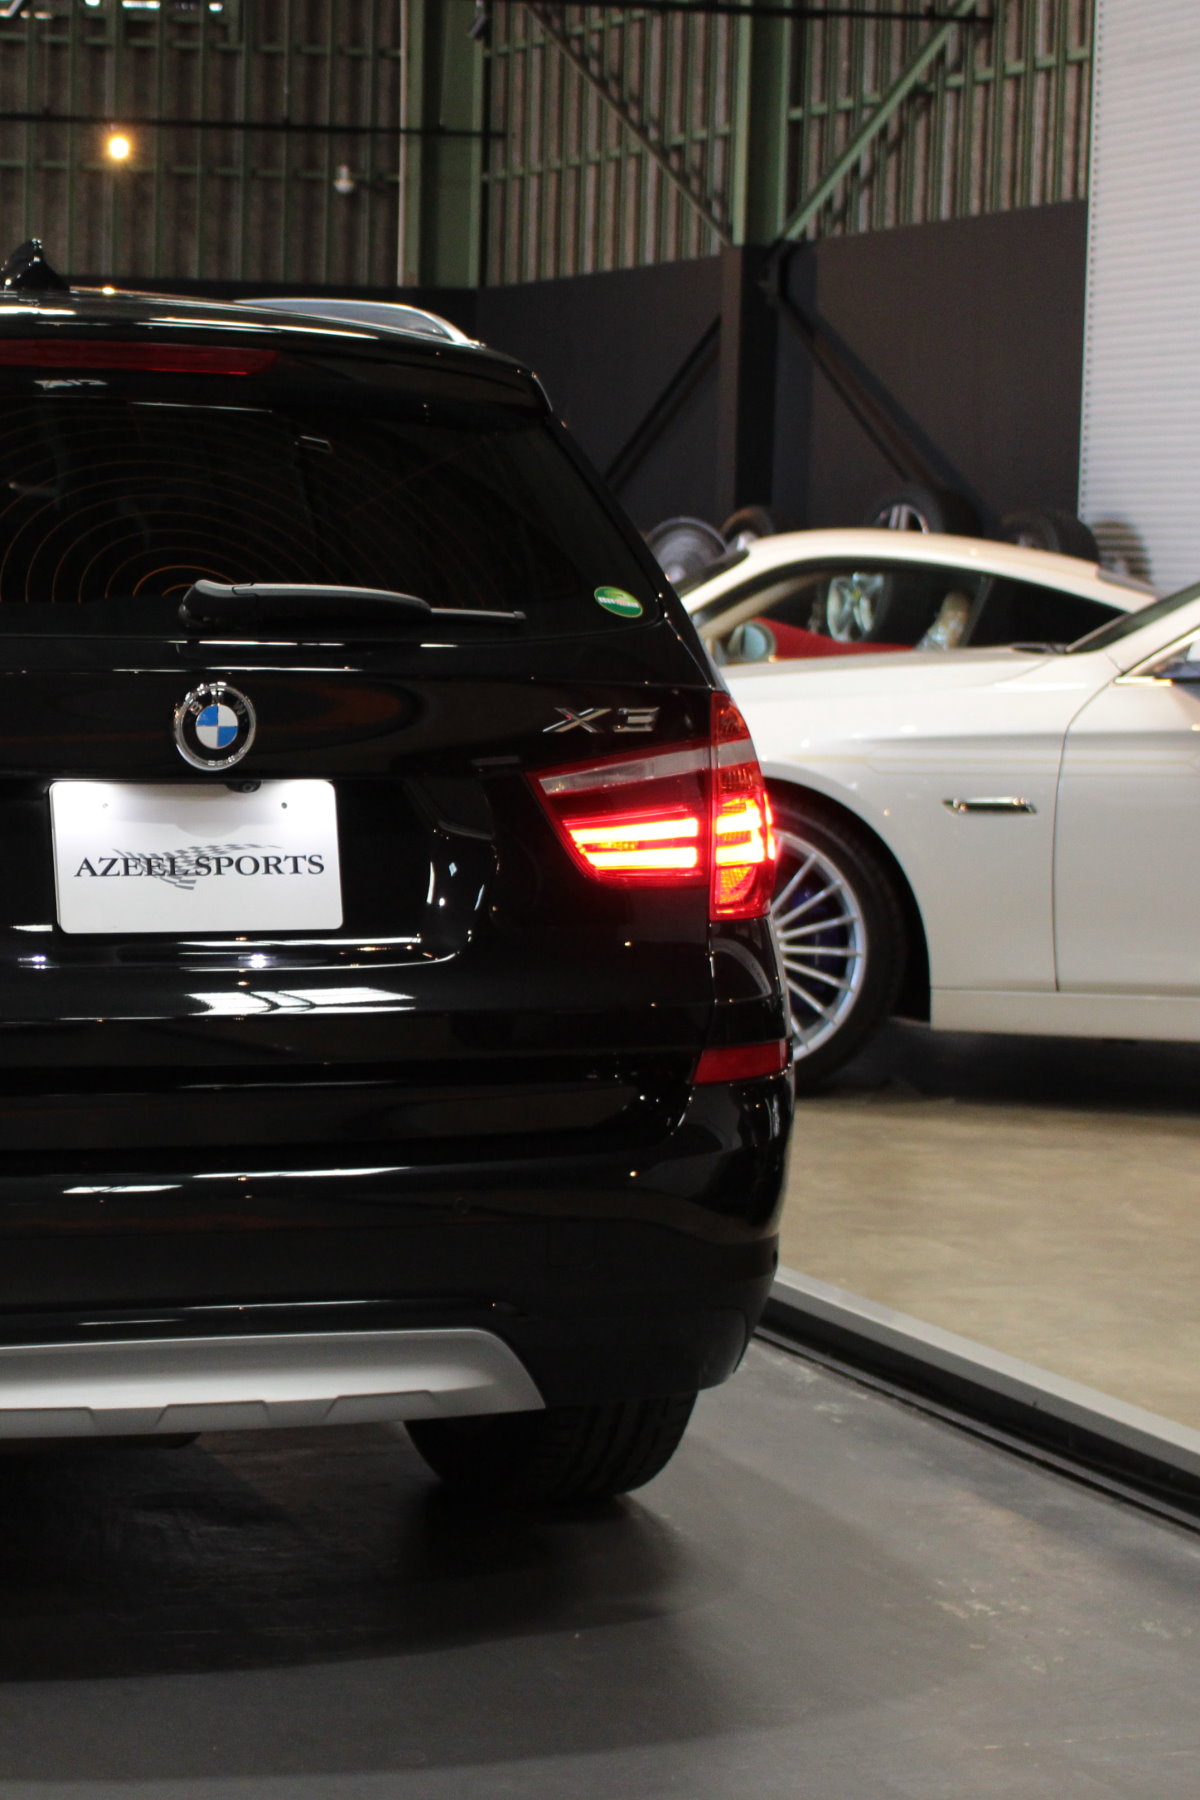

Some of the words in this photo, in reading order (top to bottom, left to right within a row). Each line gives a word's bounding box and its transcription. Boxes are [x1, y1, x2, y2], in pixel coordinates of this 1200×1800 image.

[542, 706, 660, 732] X3
[74, 857, 188, 877] AZEEL
[195, 854, 325, 876] SPORTS
